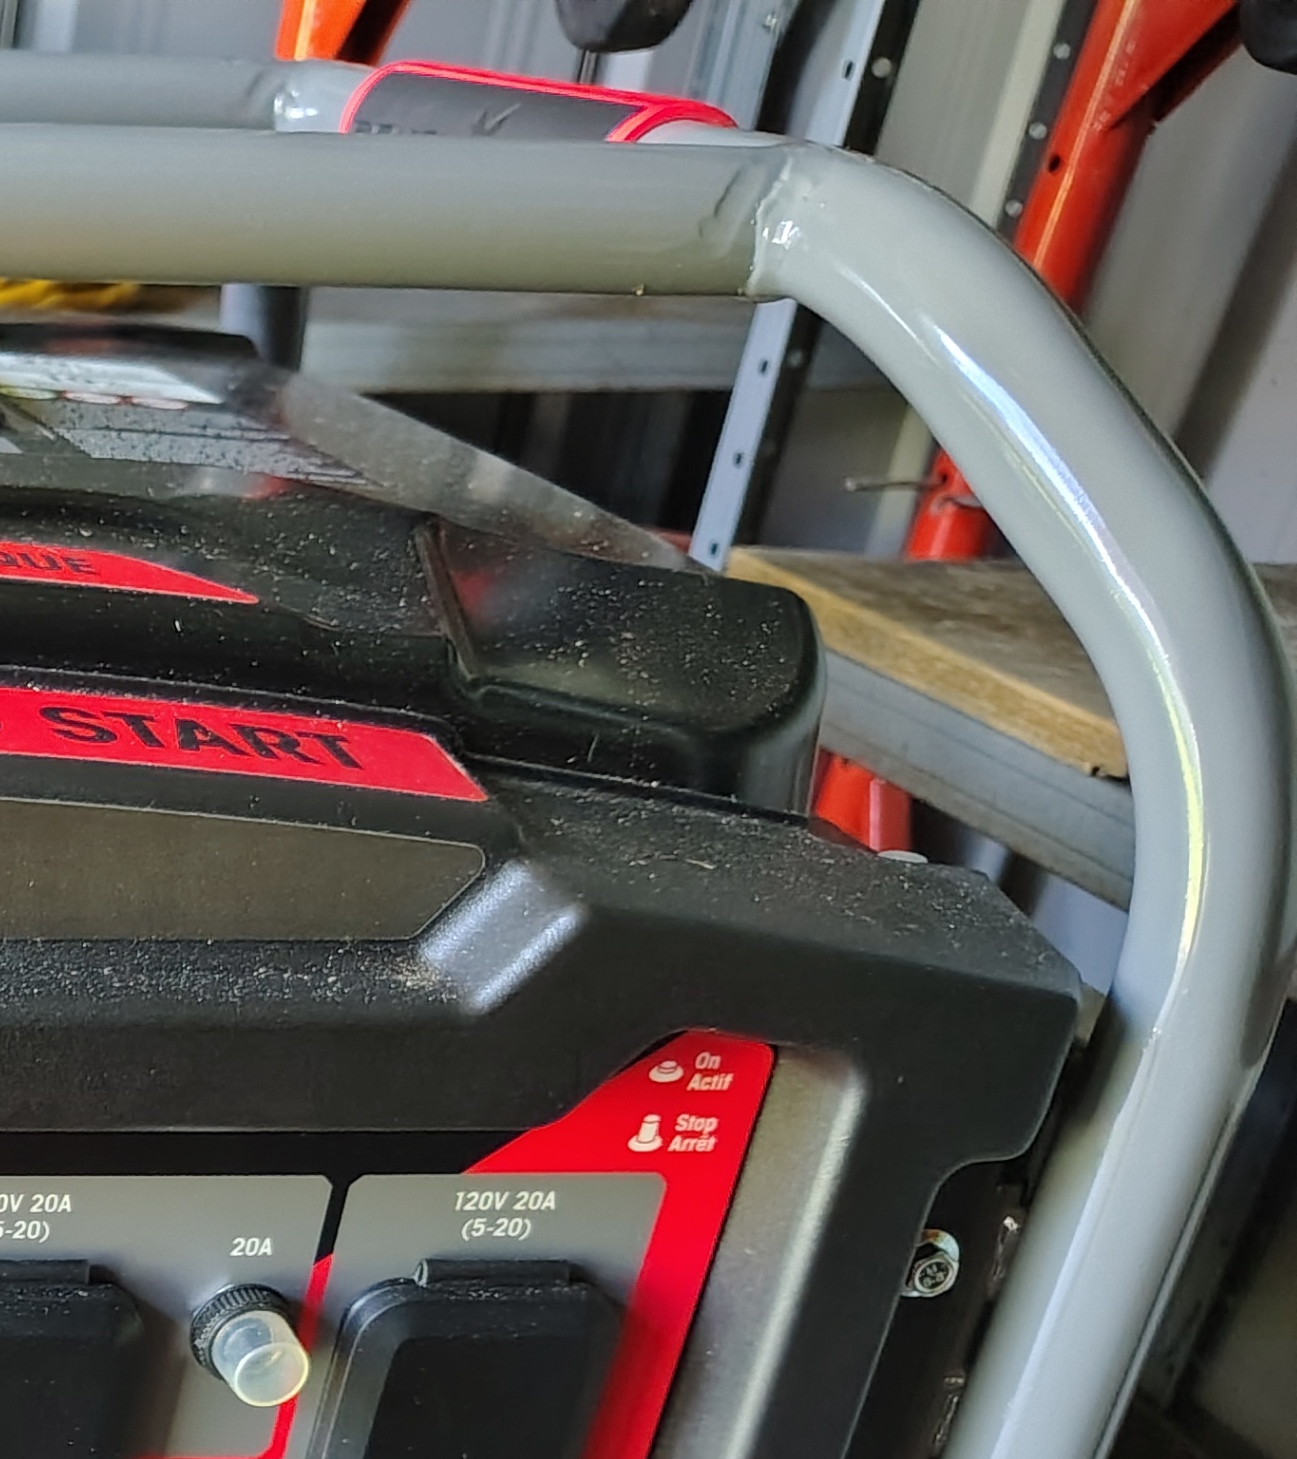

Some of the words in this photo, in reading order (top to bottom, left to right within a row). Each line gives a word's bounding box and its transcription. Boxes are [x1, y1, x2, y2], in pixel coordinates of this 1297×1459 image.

[39, 704, 365, 770] START
[695, 1051, 721, 1071] On
[686, 1072, 735, 1092] Actif
[674, 1114, 719, 1136] Stop
[31, 1192, 73, 1214] 20A
[454, 1190, 510, 1213] 120V
[513, 1190, 557, 1213] 20A
[460, 1217, 533, 1242] (5-20)
[229, 1237, 273, 1258] 20A
